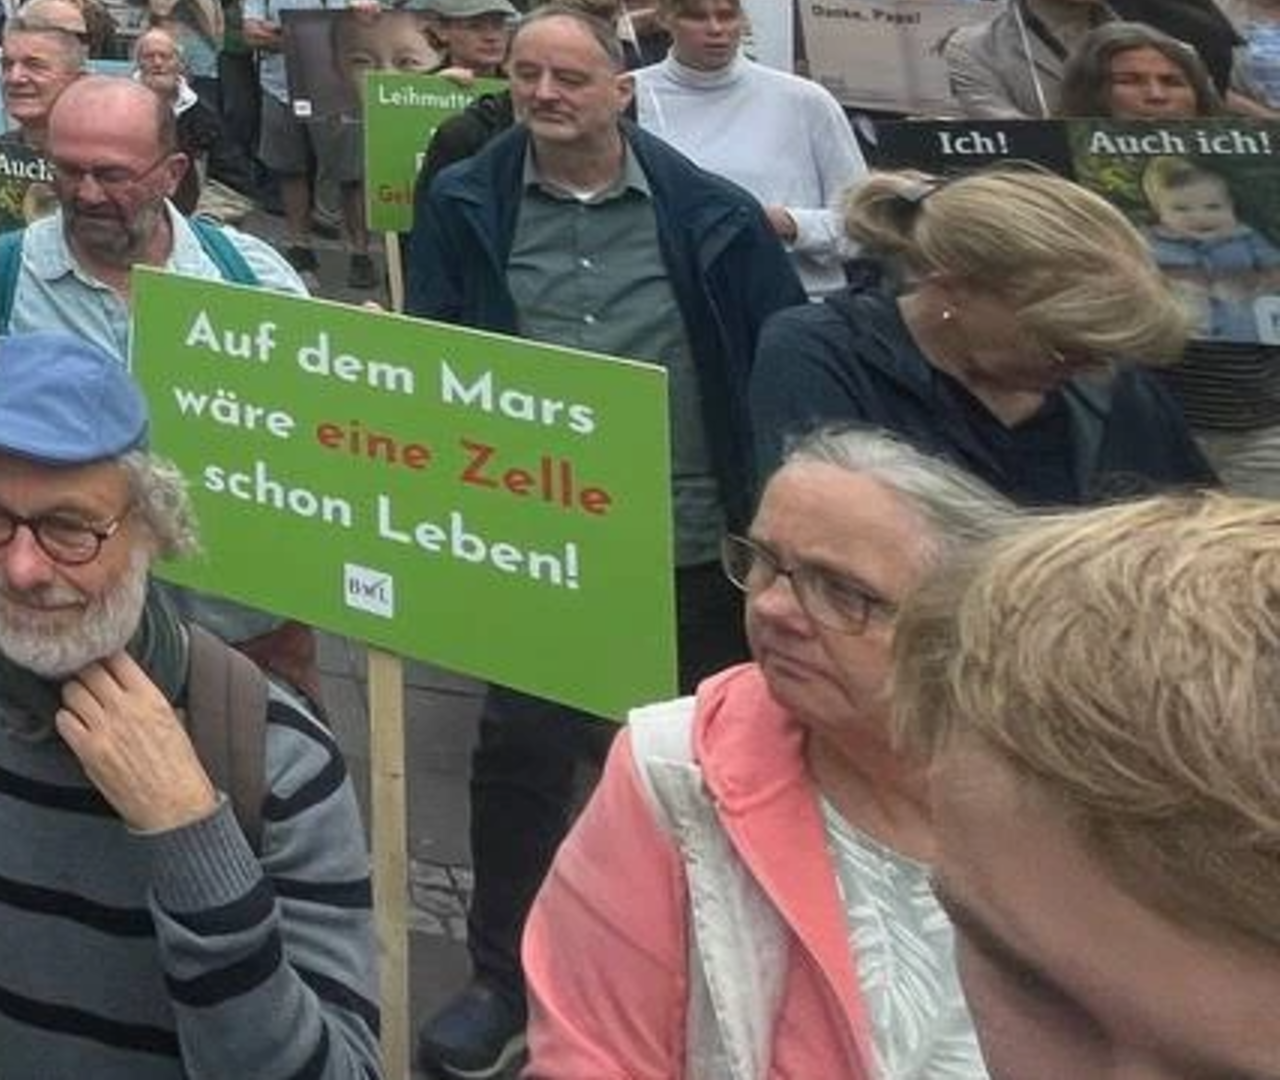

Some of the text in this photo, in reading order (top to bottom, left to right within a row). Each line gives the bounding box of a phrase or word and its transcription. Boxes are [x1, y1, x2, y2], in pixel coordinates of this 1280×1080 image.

[938, 130, 1010, 156] Ich!
[1090, 130, 1273, 156] Auch ich!
[185, 311, 595, 435] Auf dem Mars
[174, 386, 612, 515] wäre eine Zelle
[204, 461, 580, 590] schon Leben!
